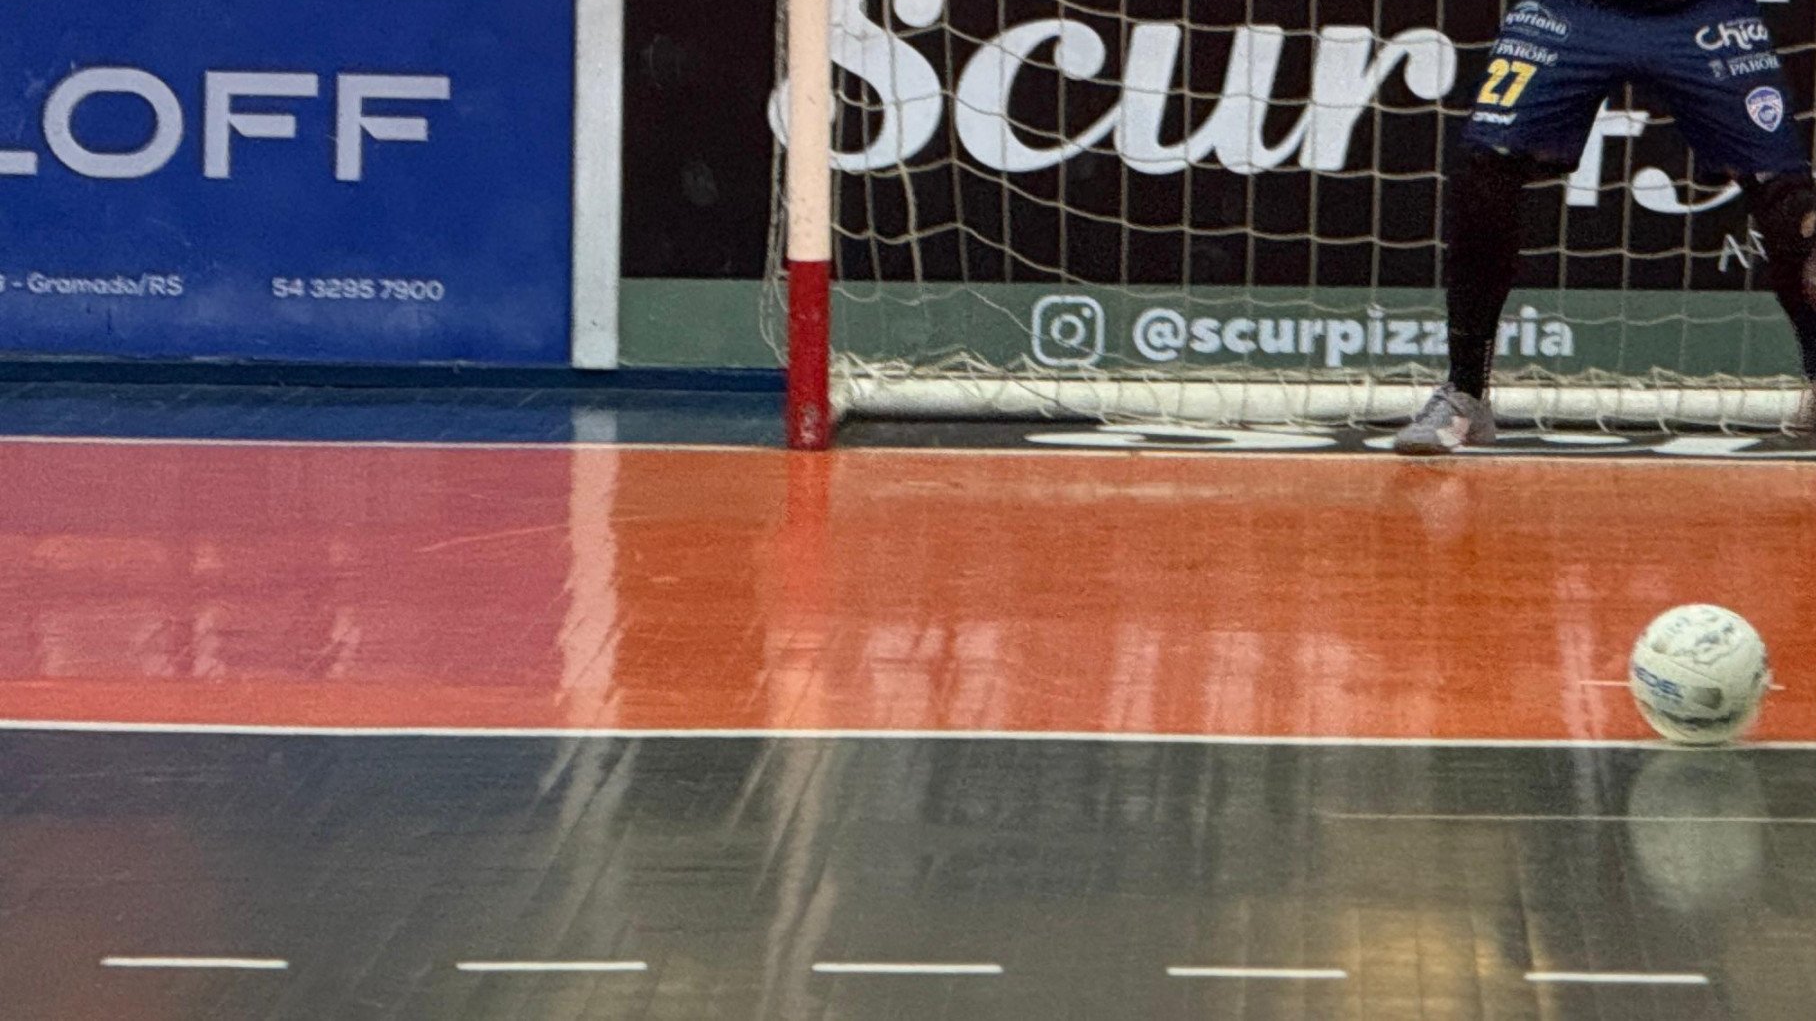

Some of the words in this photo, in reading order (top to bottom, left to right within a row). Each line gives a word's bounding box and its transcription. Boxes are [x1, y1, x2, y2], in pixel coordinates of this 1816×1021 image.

[1477, 58, 1538, 108] 27
[27, 272, 184, 296] Gramado/RS
[271, 277, 305, 298] 54
[309, 278, 375, 299] 3295
[379, 279, 445, 301] 7900
[1132, 305, 1575, 368] @scurpizzria
